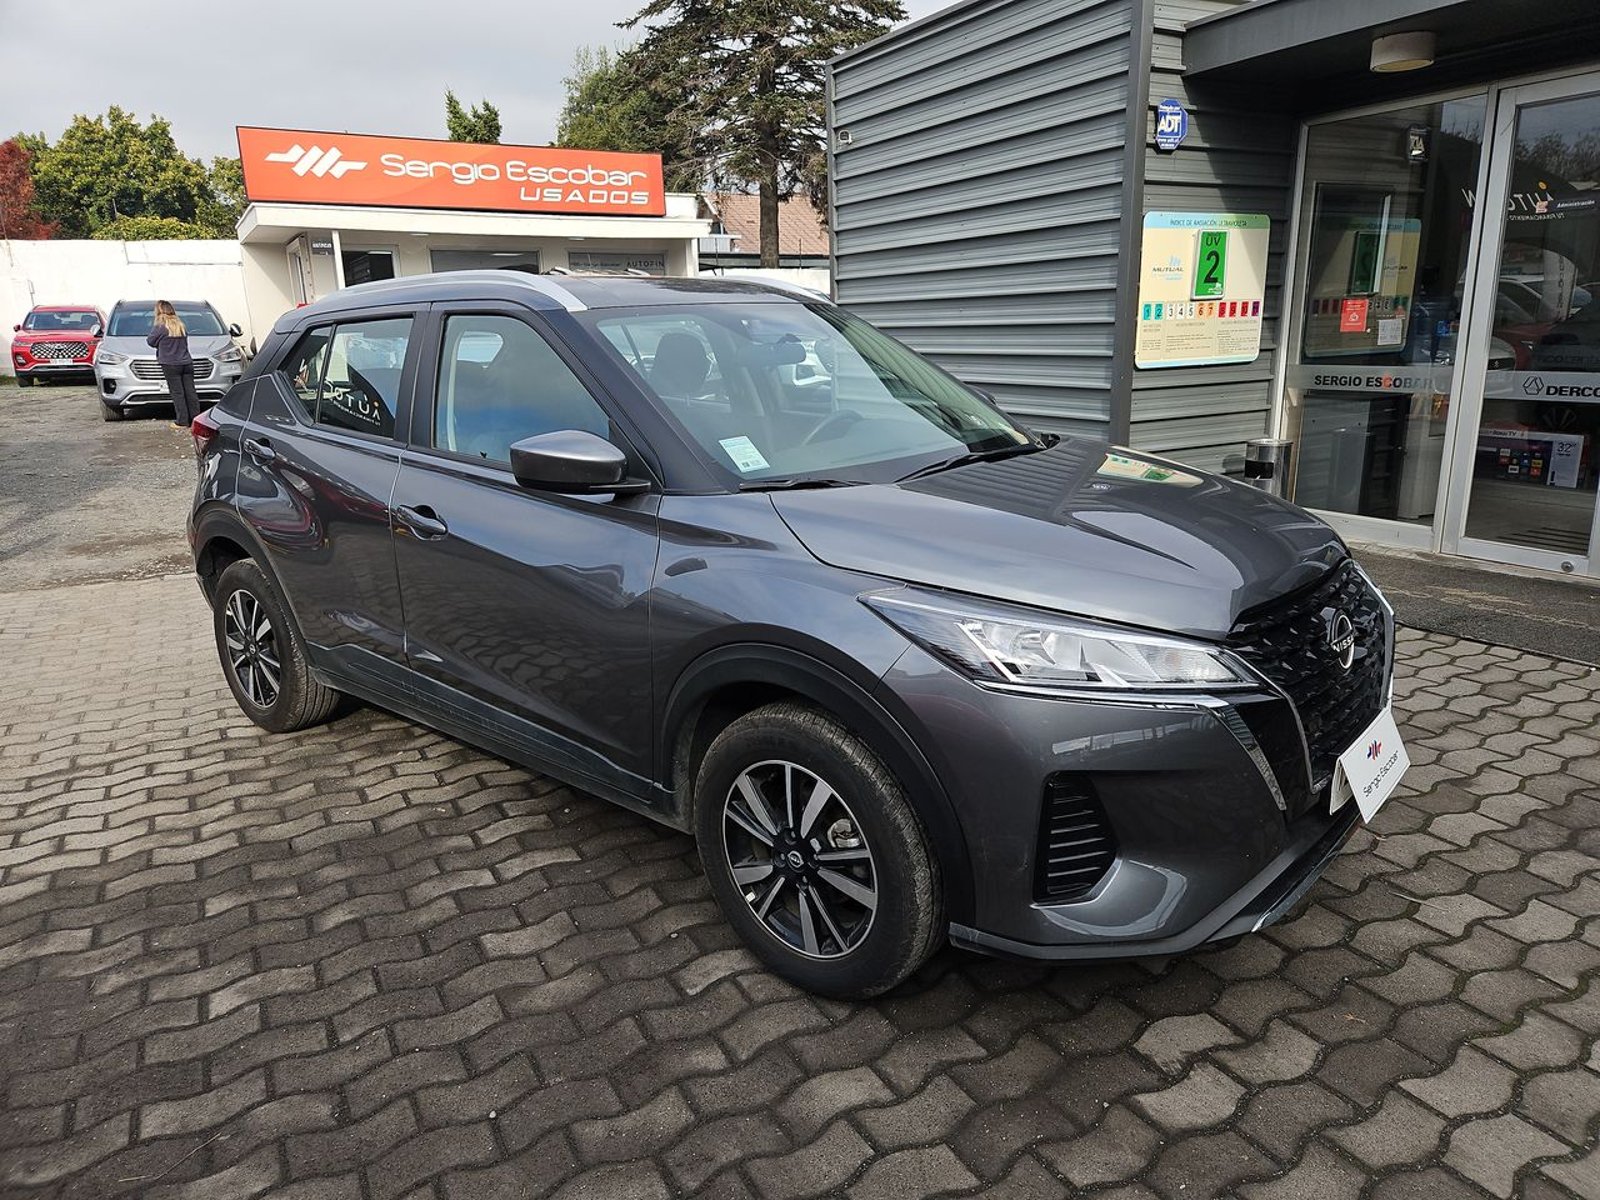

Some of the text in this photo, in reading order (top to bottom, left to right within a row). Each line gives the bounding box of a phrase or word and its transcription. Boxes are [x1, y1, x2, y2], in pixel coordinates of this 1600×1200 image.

[1158, 115, 1181, 133] ADT
[380, 152, 648, 187] Sergio Escobar
[519, 187, 650, 206] USADOS
[1205, 236, 1221, 247] UV
[626, 260, 665, 268] AUTOFIN
[1203, 249, 1220, 284] 2
[1168, 308, 1174, 317] 3
[1178, 307, 1184, 317] 4
[1188, 307, 1194, 317] 5
[1198, 307, 1204, 316] 6
[1207, 307, 1213, 316] 7
[1314, 375, 1362, 387] SERGIO
